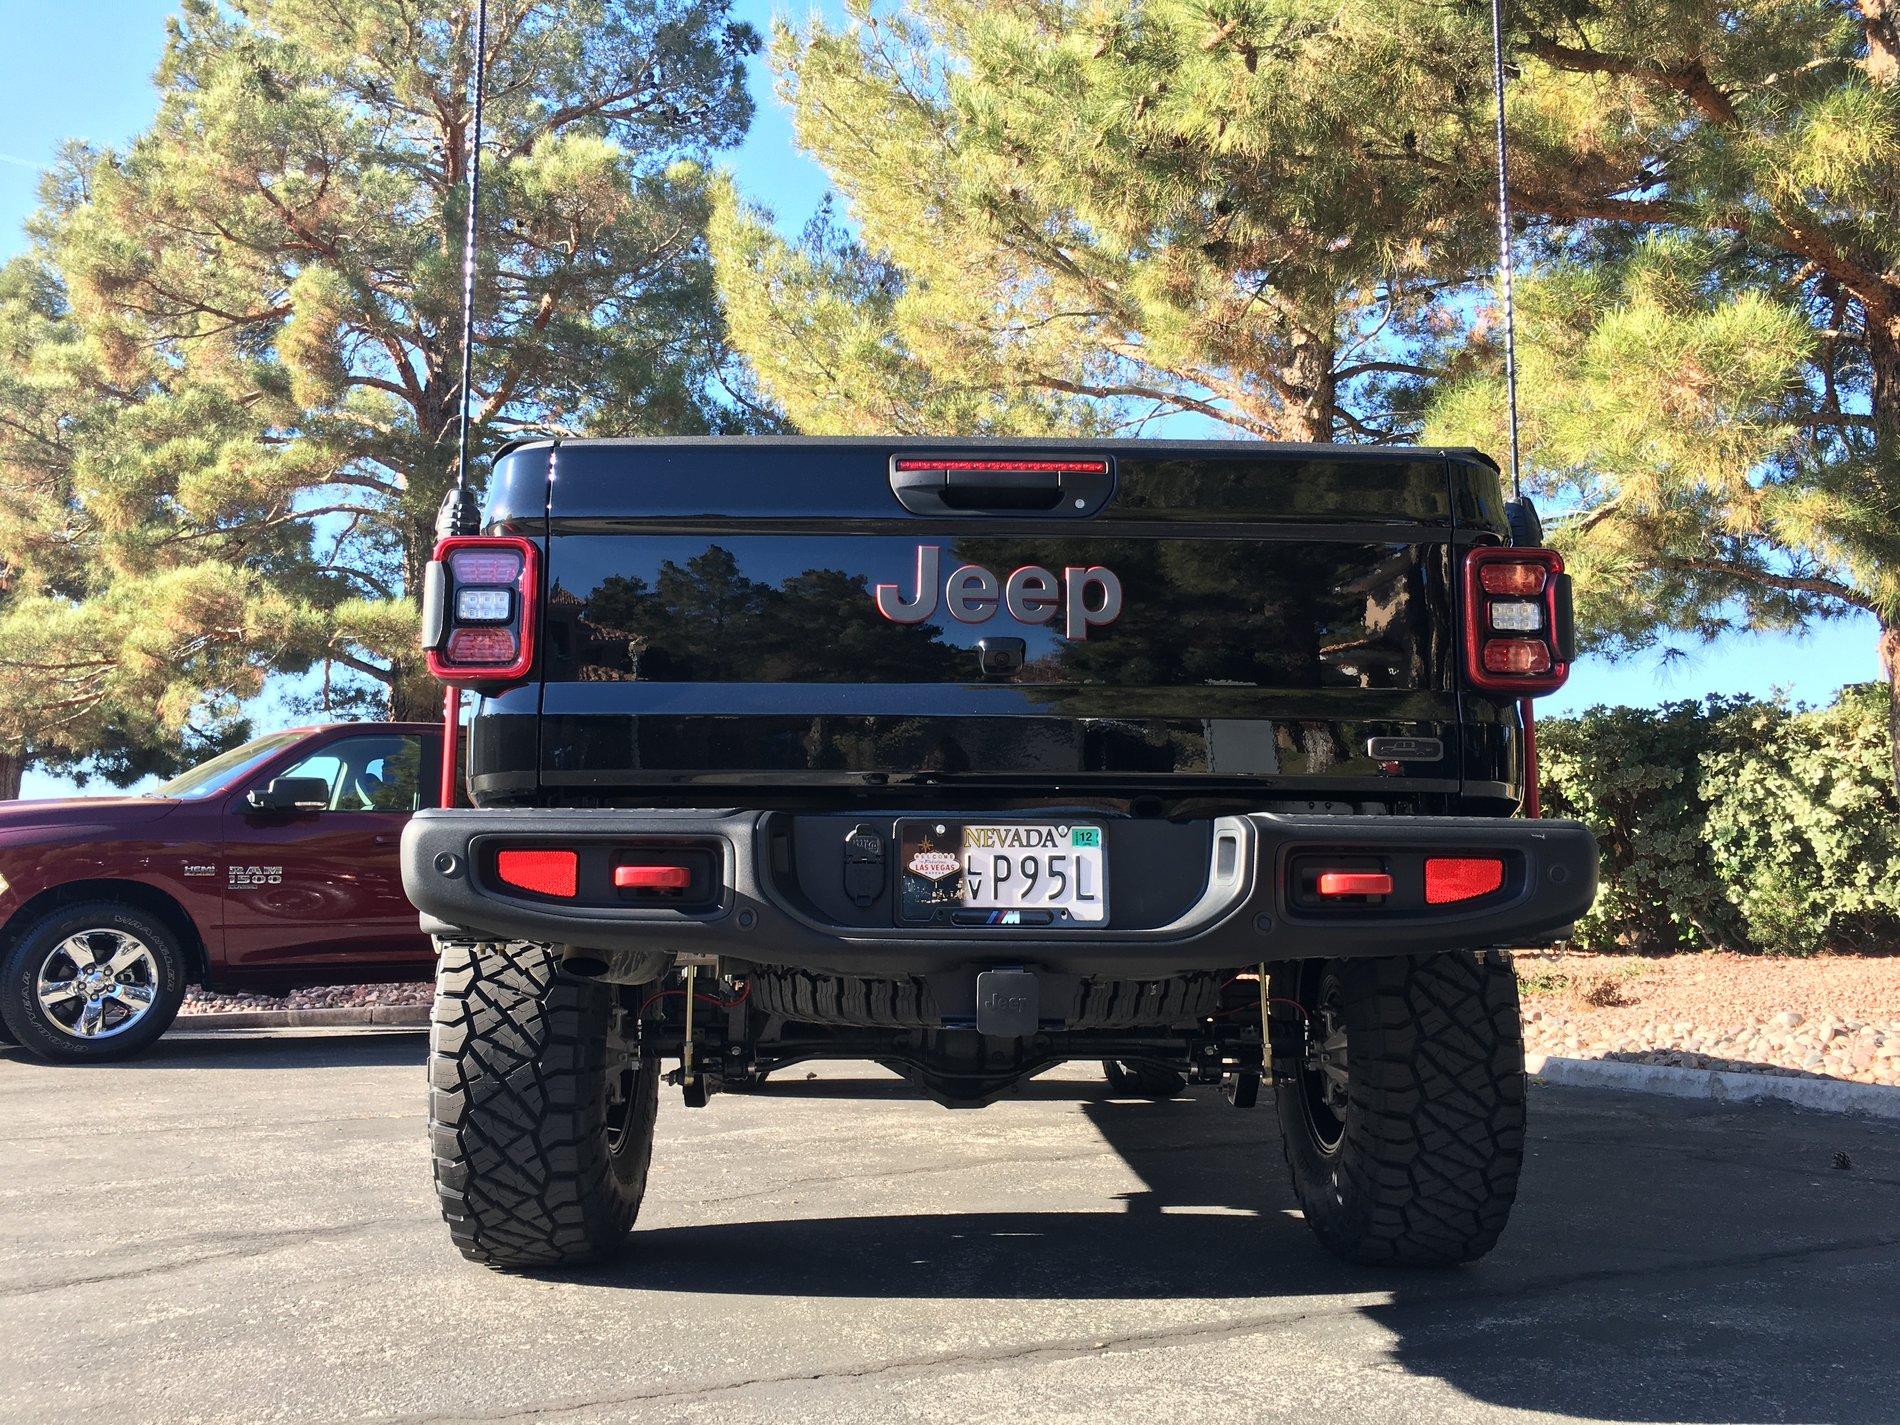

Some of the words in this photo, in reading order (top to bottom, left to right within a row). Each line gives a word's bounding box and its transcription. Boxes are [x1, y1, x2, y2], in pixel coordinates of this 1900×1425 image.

[875, 544, 1123, 641] Jeep
[963, 828, 1059, 848] NEVADA
[1080, 831, 1093, 842] 12
[228, 866, 283, 875] RAM
[228, 875, 282, 884] 1500
[993, 854, 1095, 900] P95L
[22, 971, 89, 1052] GOODYEAR
